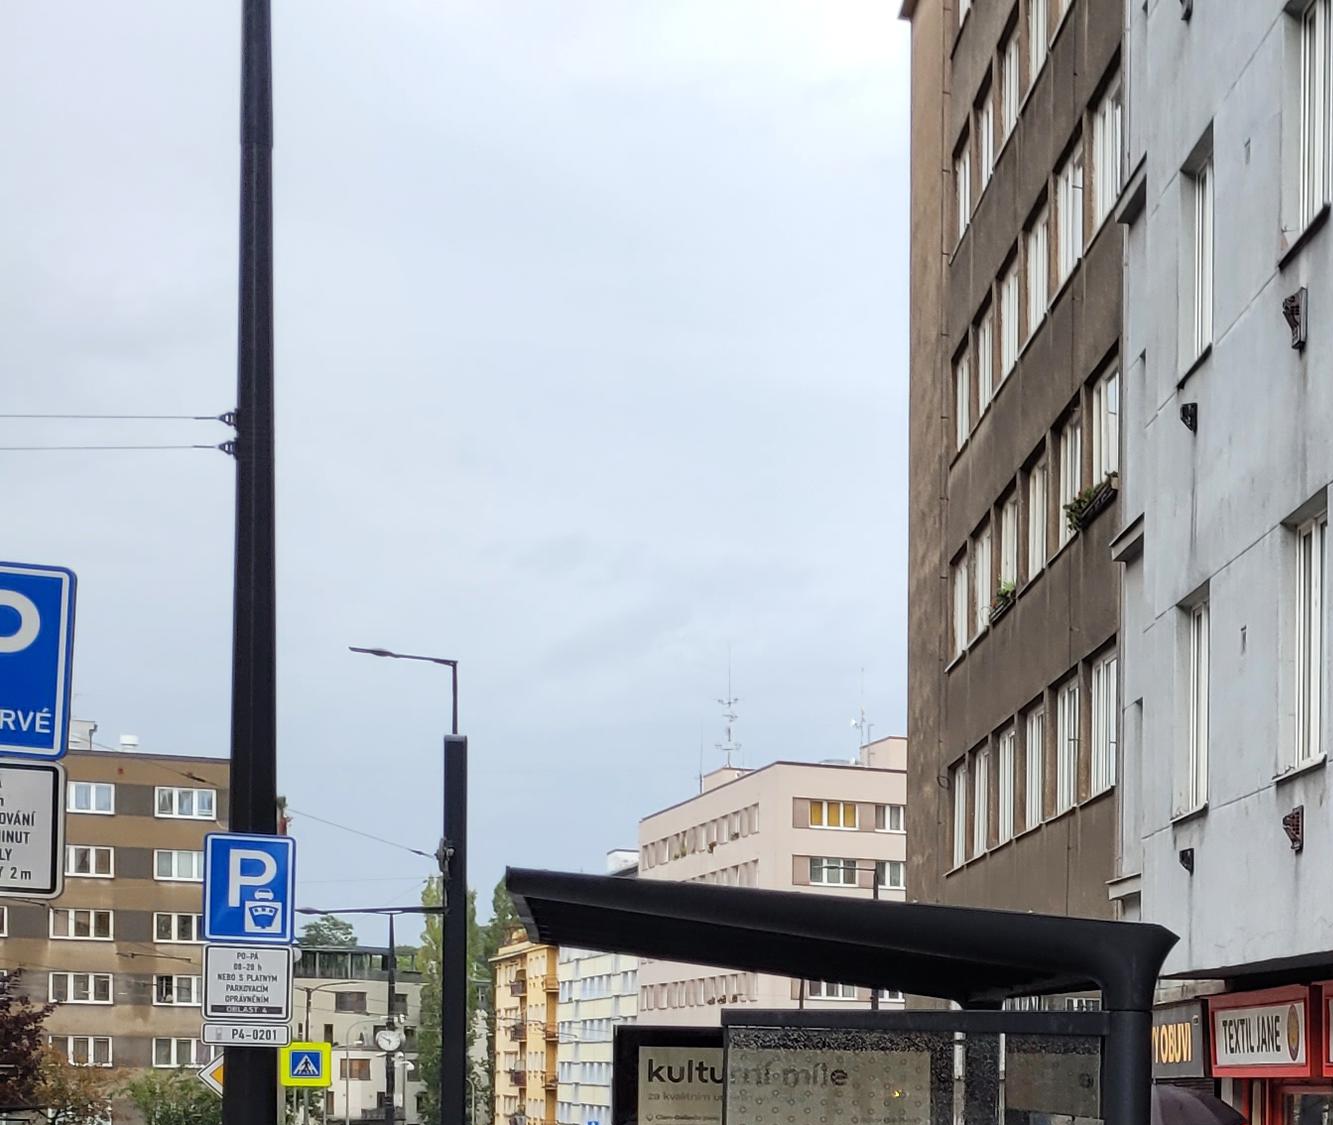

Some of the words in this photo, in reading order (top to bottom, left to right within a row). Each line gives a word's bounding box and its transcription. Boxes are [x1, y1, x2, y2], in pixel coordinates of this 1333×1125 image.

[0, 830, 30, 844] INUT
[10, 866, 18, 879] 2
[20, 870, 32, 880] m
[228, 848, 277, 908] P
[217, 973, 236, 981] NEBO
[239, 973, 244, 981] S
[231, 1028, 277, 1040] P4-0201
[1222, 1017, 1255, 1055] TEXTIL
[1256, 1015, 1281, 1053] JANE
[1159, 1022, 1192, 1064] OBUVI
